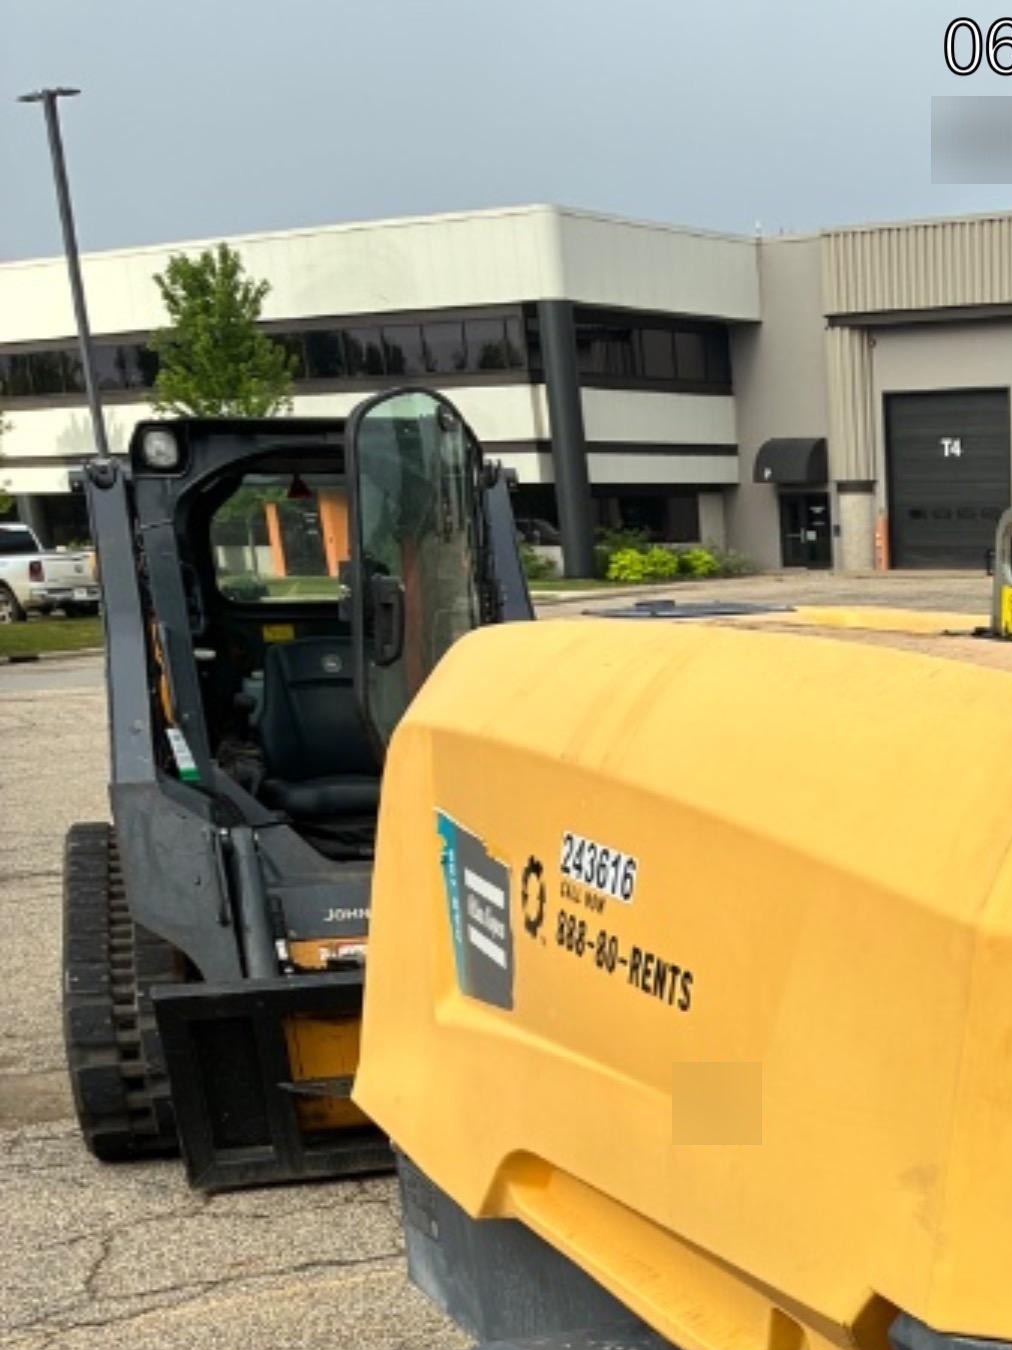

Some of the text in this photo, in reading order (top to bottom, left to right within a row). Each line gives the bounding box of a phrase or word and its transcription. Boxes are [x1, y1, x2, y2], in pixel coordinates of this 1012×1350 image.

[941, 437, 961, 457] T4
[561, 834, 636, 901] 243616
[556, 909, 693, 1012] 888-80-RENTS
